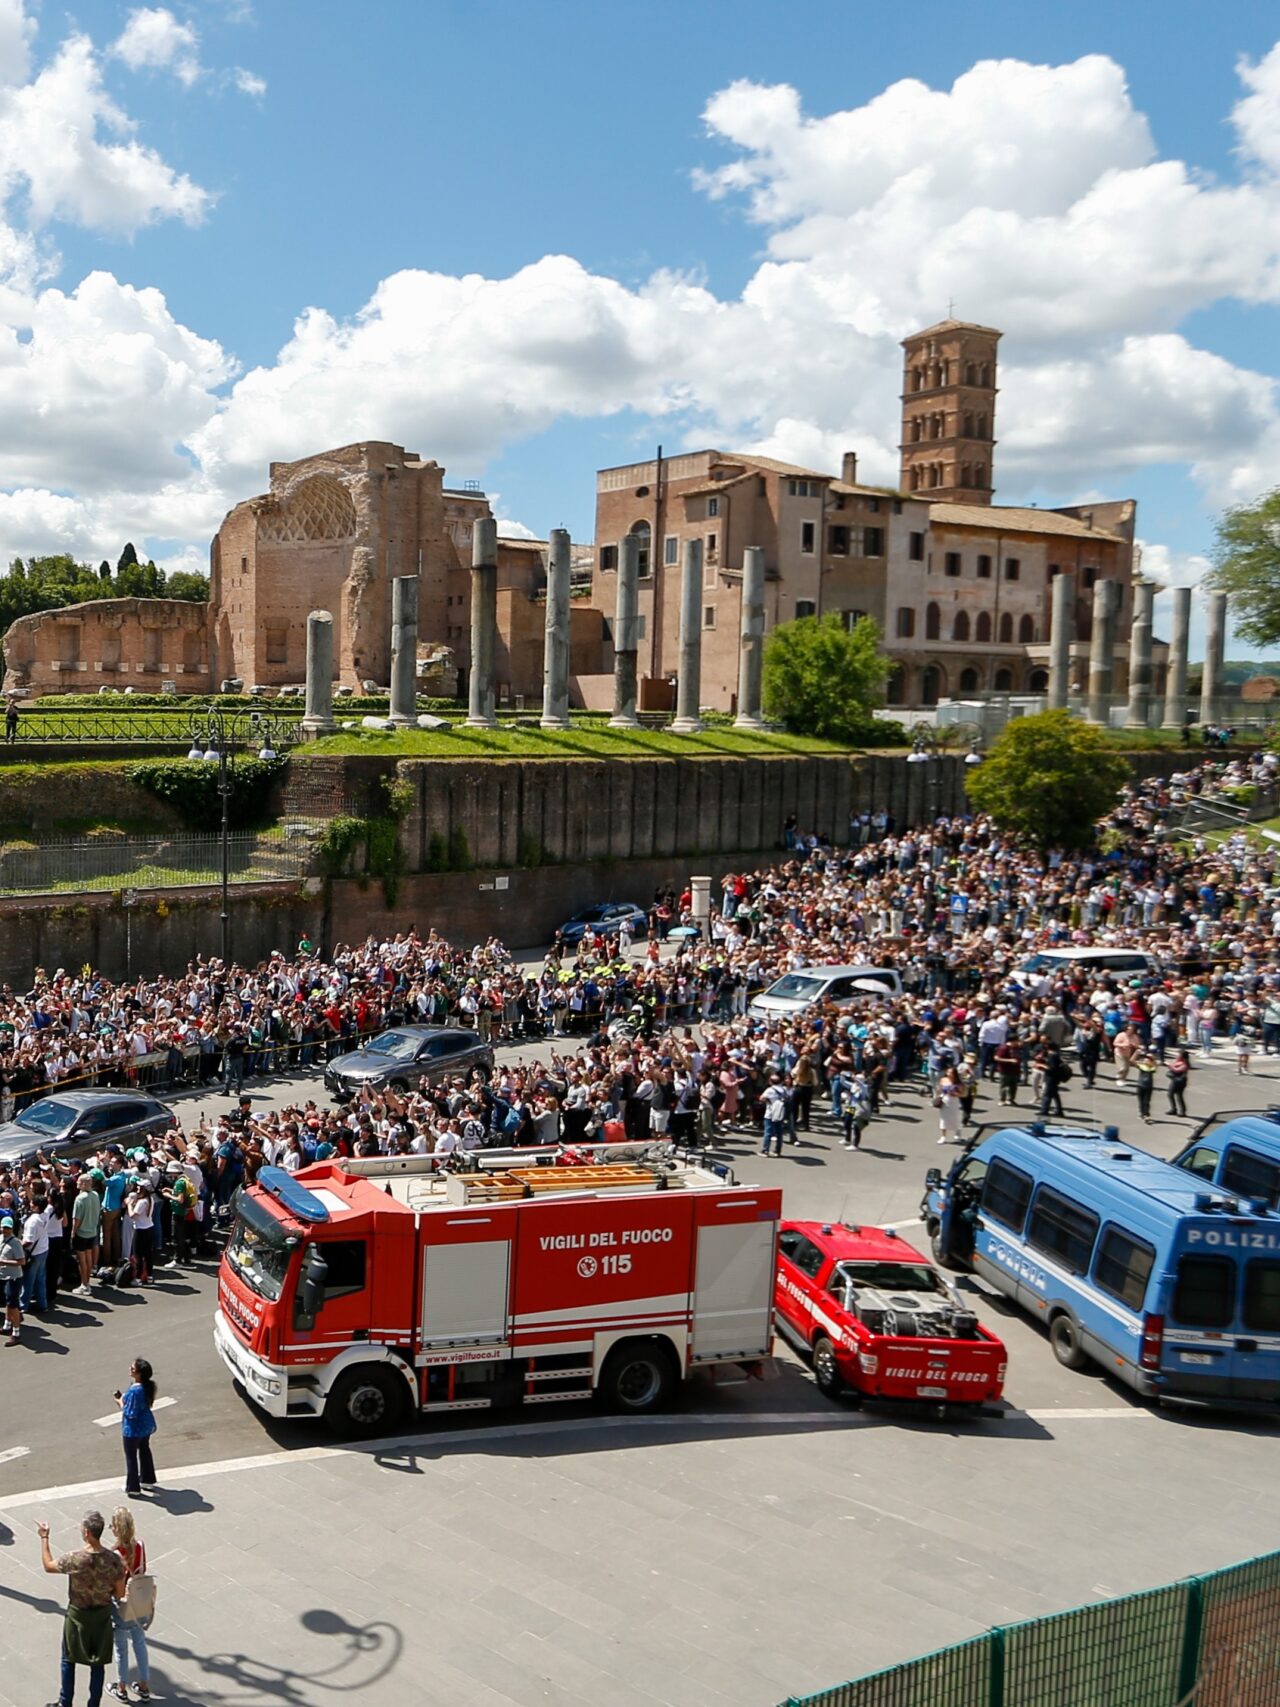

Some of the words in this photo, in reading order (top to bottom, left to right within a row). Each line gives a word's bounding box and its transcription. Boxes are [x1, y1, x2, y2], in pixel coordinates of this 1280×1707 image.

[540, 1234, 585, 1250] VIGILI
[589, 1232, 617, 1247] DEL
[621, 1228, 673, 1245] FUOCO
[1187, 1229, 1280, 1249] POLIZI
[601, 1254, 632, 1275] 115
[988, 1238, 1046, 1290] POLIZIA
[229, 1291, 239, 1310] DEL
[238, 1302, 259, 1328] FUOCO
[426, 1350, 501, 1363] www.vigilfuoco.it
[885, 1367, 923, 1379] VIGILI
[926, 1370, 947, 1381] DEL
[950, 1372, 989, 1383] FUOCO
